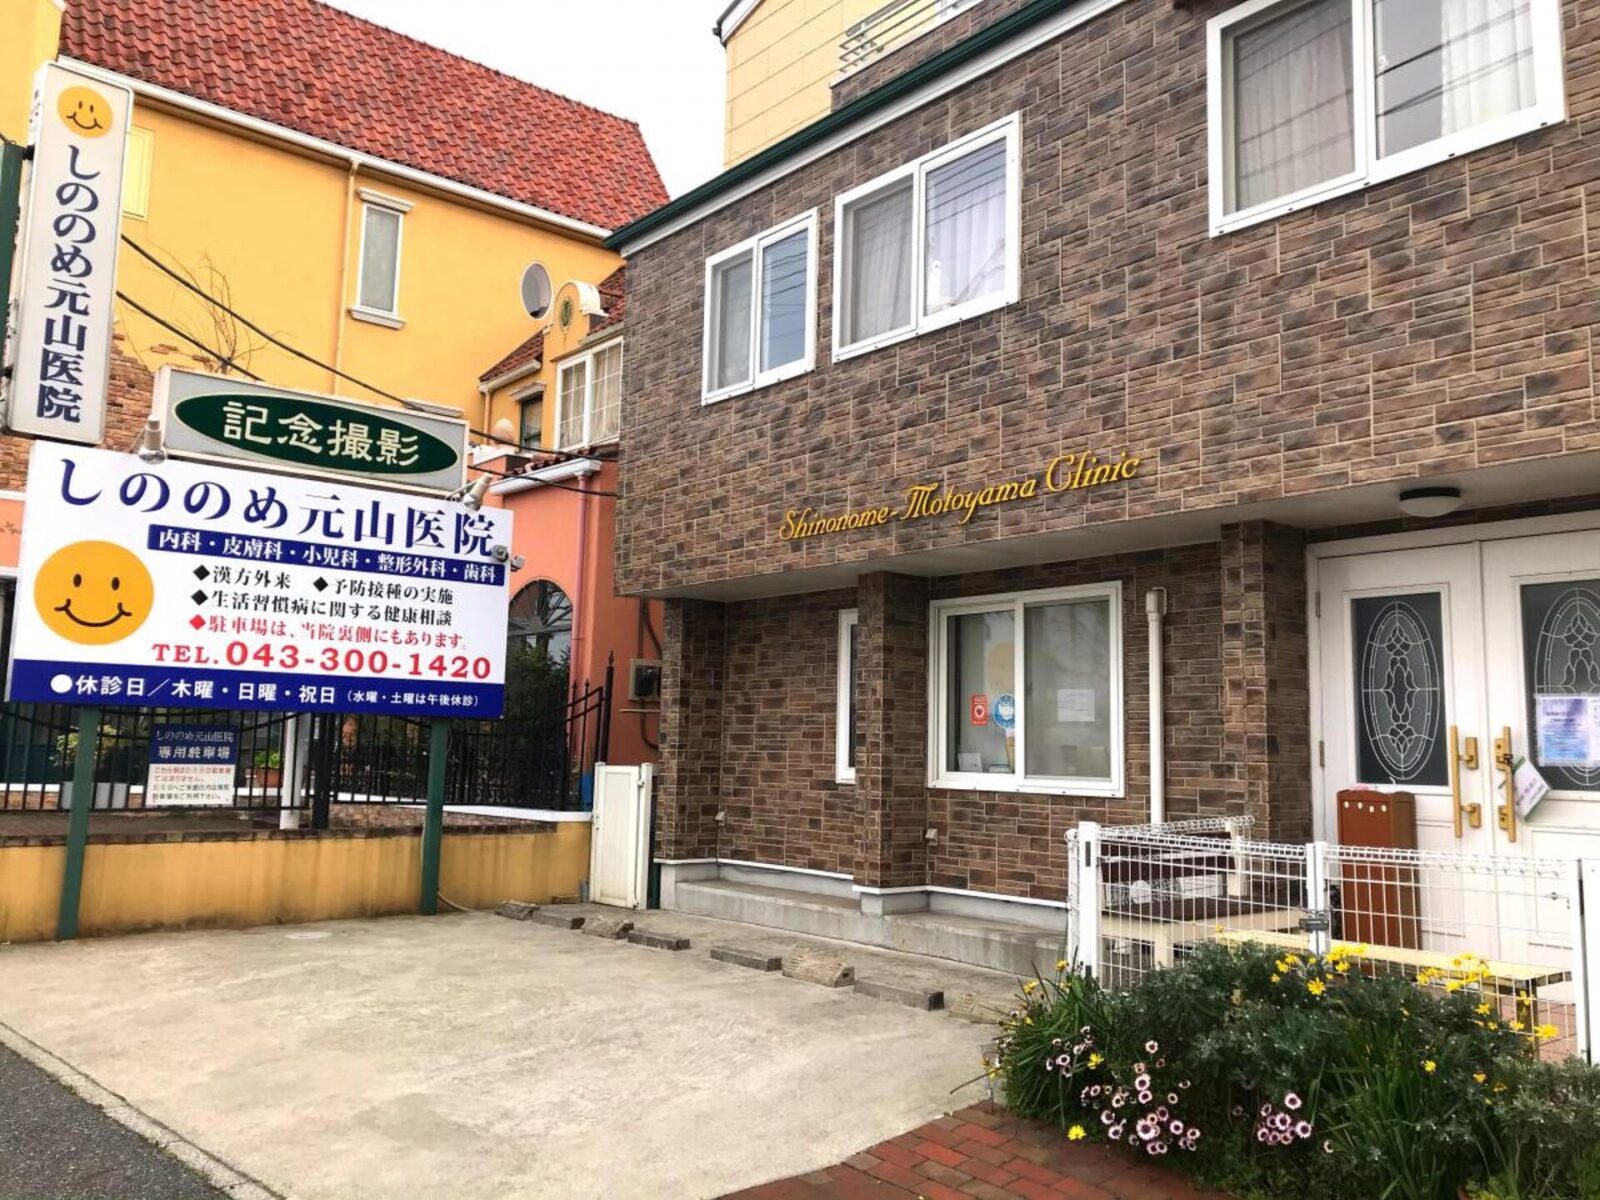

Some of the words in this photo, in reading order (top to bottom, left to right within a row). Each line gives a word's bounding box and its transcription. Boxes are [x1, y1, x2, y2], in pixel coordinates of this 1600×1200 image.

[36, 144, 101, 424] しののめ元山医院
[222, 400, 419, 467] 記念撮影
[1045, 449, 1142, 494] Clinic
[61, 458, 495, 557] しののめ元山医院
[213, 564, 292, 590] 漢方外来
[333, 578, 454, 605] 予防接種の実施
[211, 589, 453, 627] 生活習慣病に関する健康相談
[156, 729, 235, 743] しののめ元山医院
[158, 745, 231, 760] 専用駐車場
